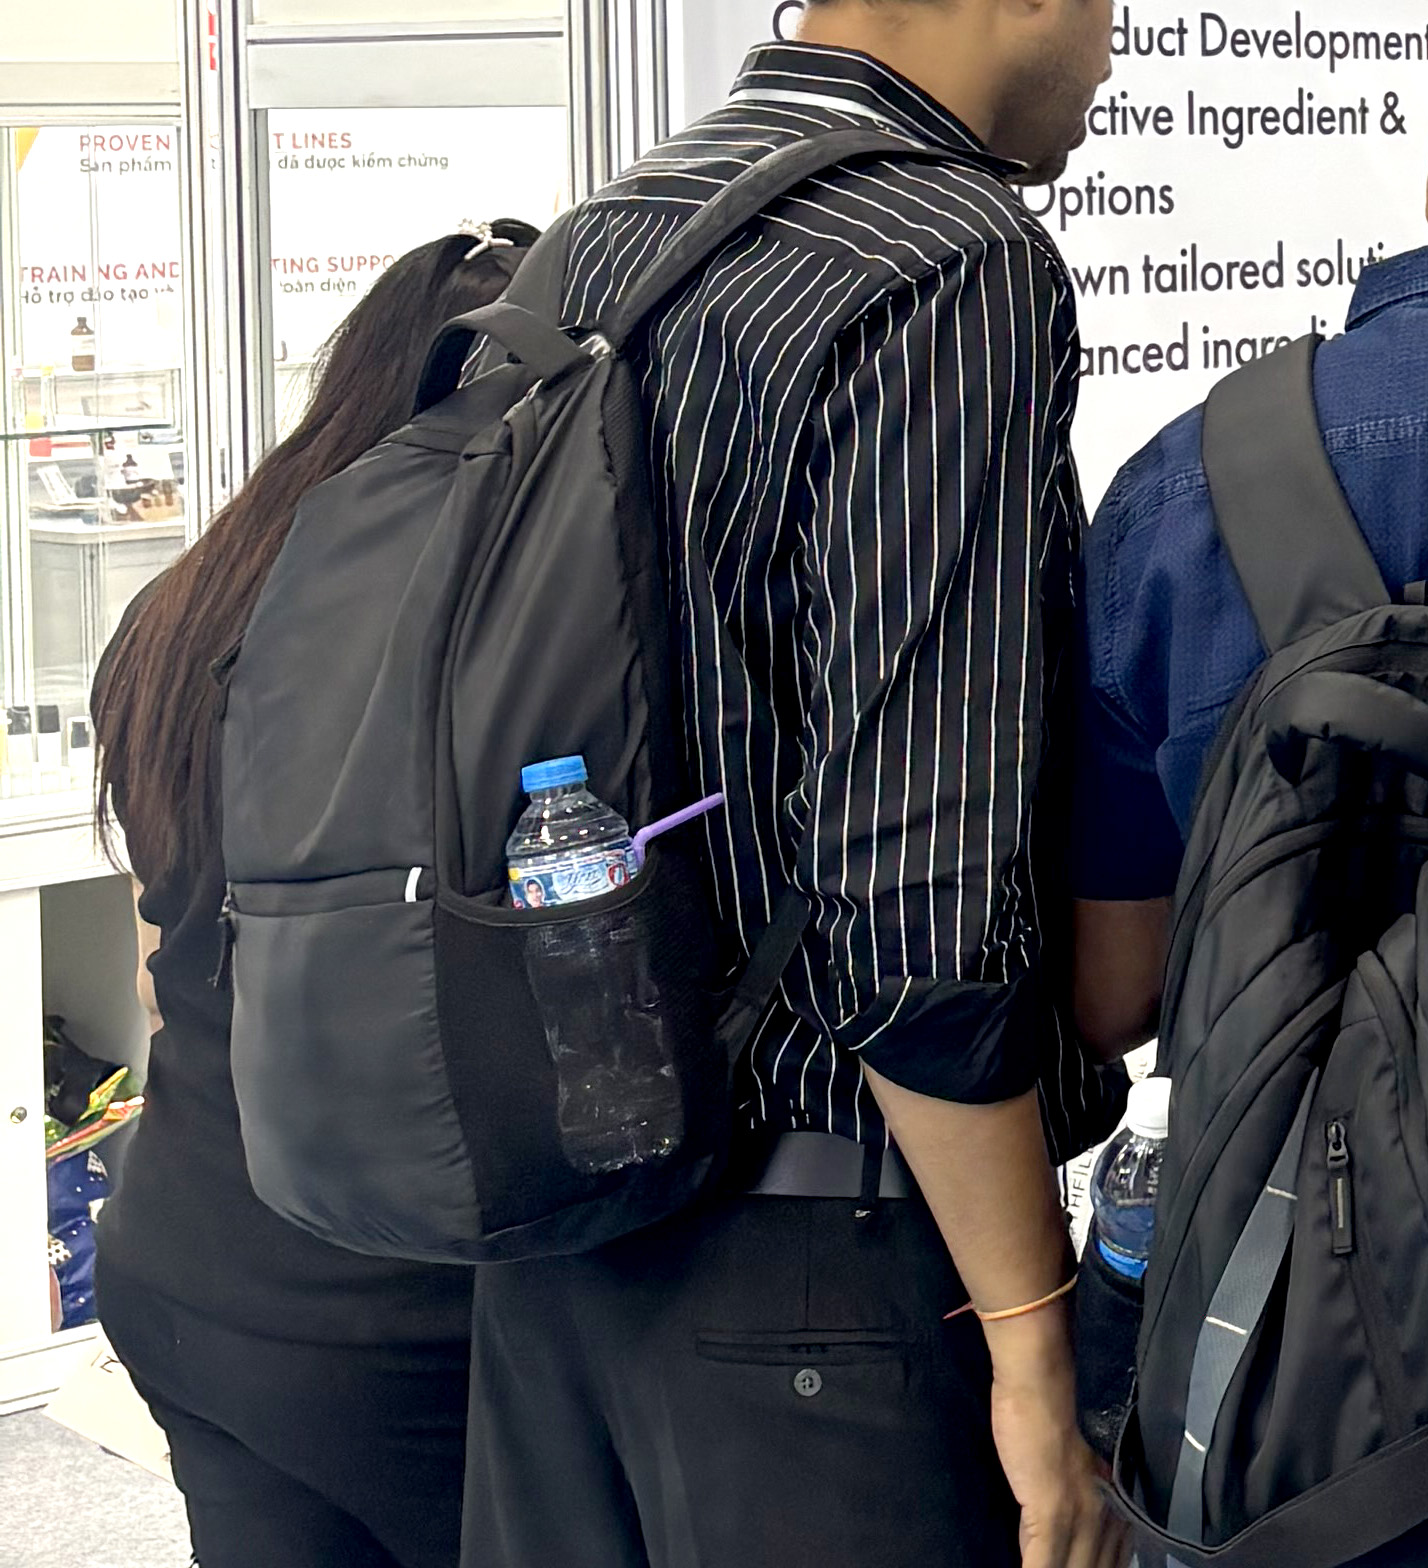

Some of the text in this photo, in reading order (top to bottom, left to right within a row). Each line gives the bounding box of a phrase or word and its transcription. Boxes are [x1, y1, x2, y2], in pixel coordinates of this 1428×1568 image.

[1110, 6, 1188, 57] duct
[79, 134, 170, 152] PROVEN
[291, 133, 352, 149] LINES
[1088, 89, 1408, 149] ctive Ingredient &
[1018, 171, 1175, 231] Options
[1143, 240, 1284, 295] tailored
